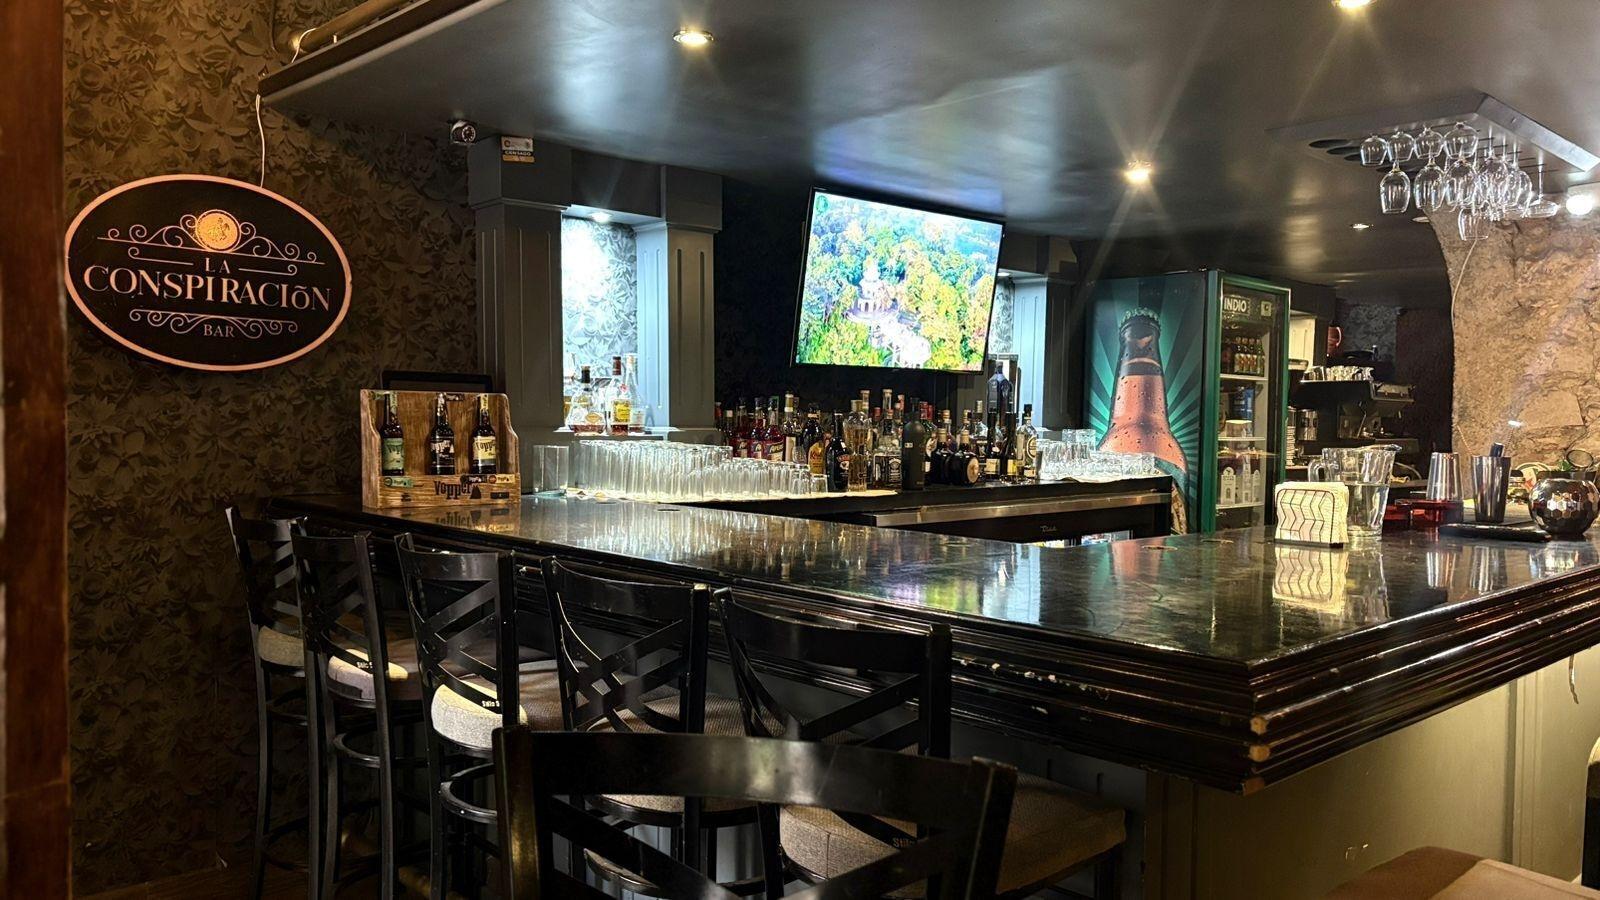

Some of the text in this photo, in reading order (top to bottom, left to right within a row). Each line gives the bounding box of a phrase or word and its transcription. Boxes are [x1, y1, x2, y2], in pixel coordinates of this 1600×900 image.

[205, 257, 231, 274] LA
[1224, 297, 1247, 312] INDIO
[203, 323, 235, 338] BAR
